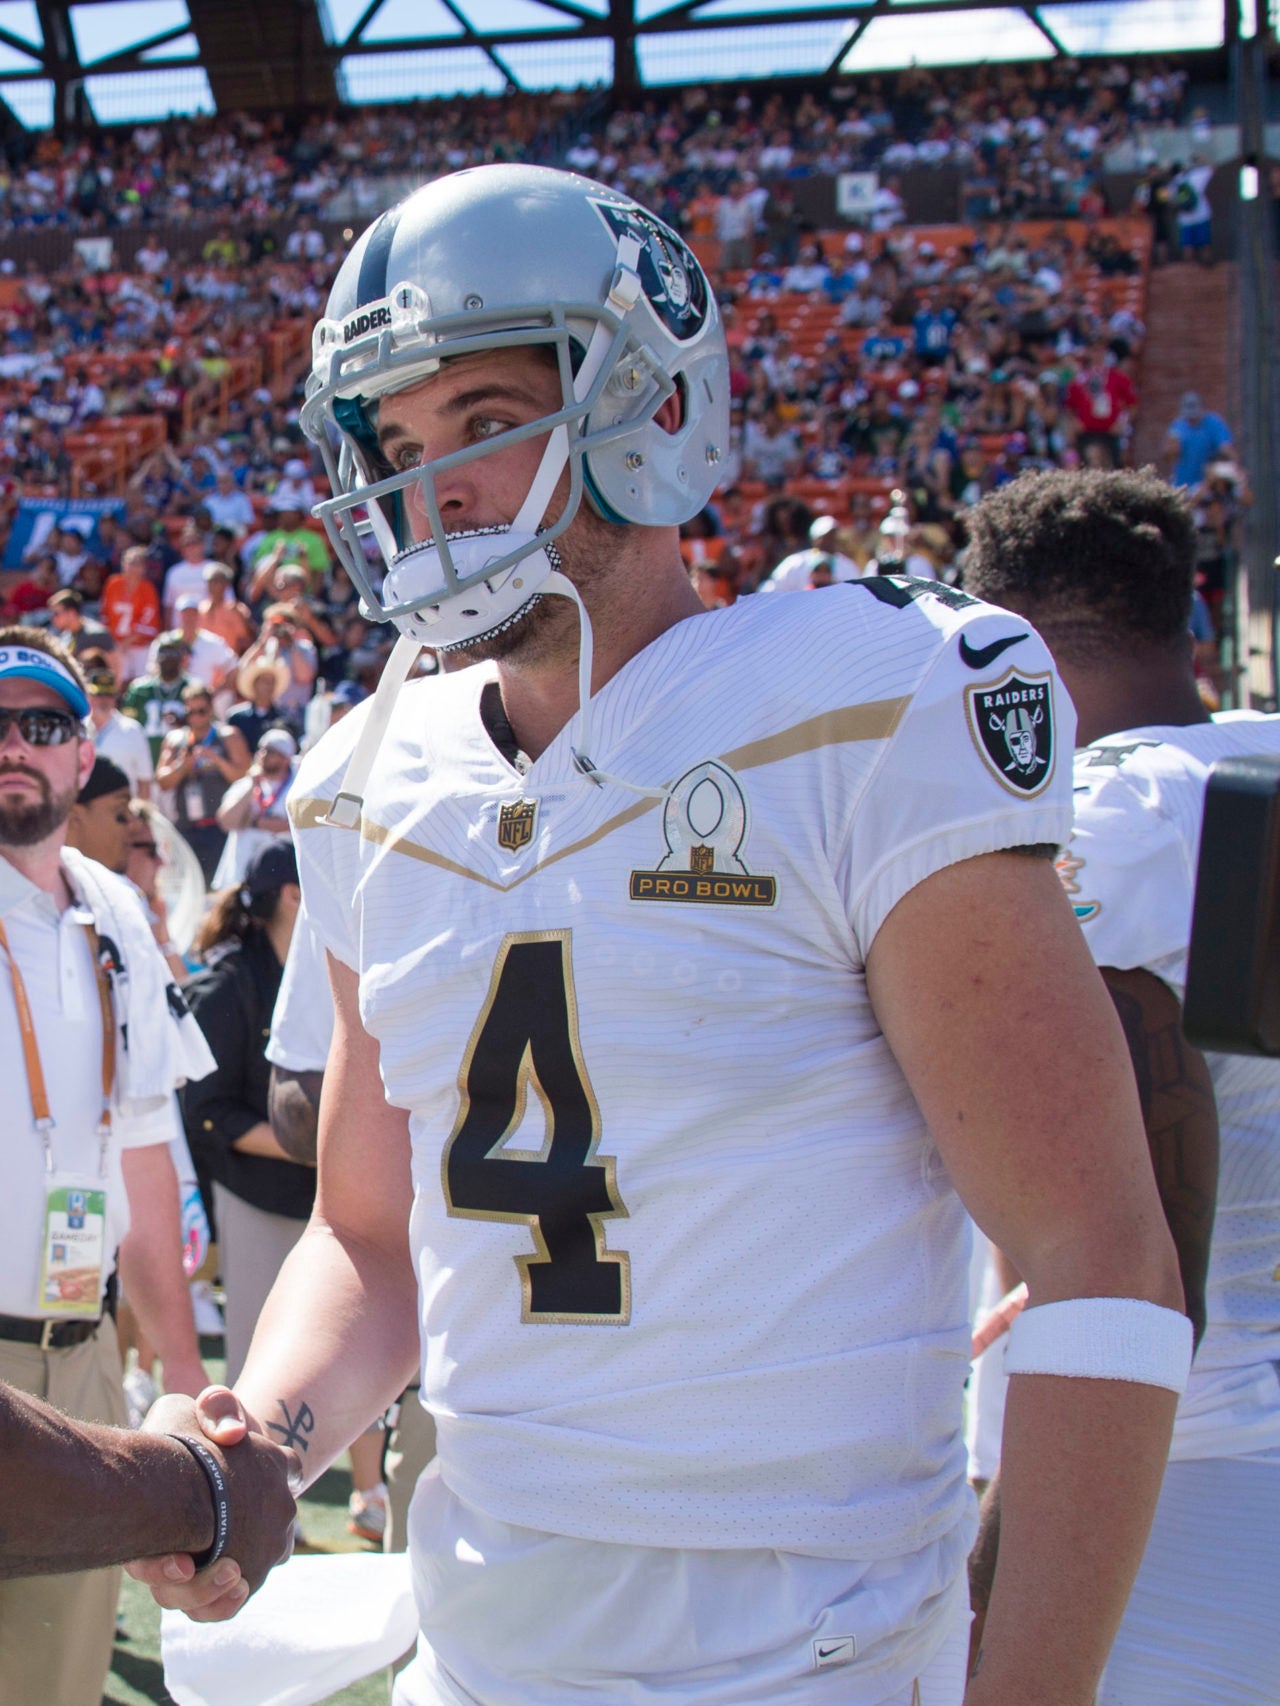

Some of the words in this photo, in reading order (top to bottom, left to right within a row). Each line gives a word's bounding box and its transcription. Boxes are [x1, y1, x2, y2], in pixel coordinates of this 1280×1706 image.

[983, 687, 1045, 708] RAIDERS
[502, 820, 530, 844] NFL
[639, 879, 689, 896] PRO
[696, 881, 768, 899] BOWL
[440, 927, 632, 1327] 4
[206, 1459, 224, 1491] MAKE
